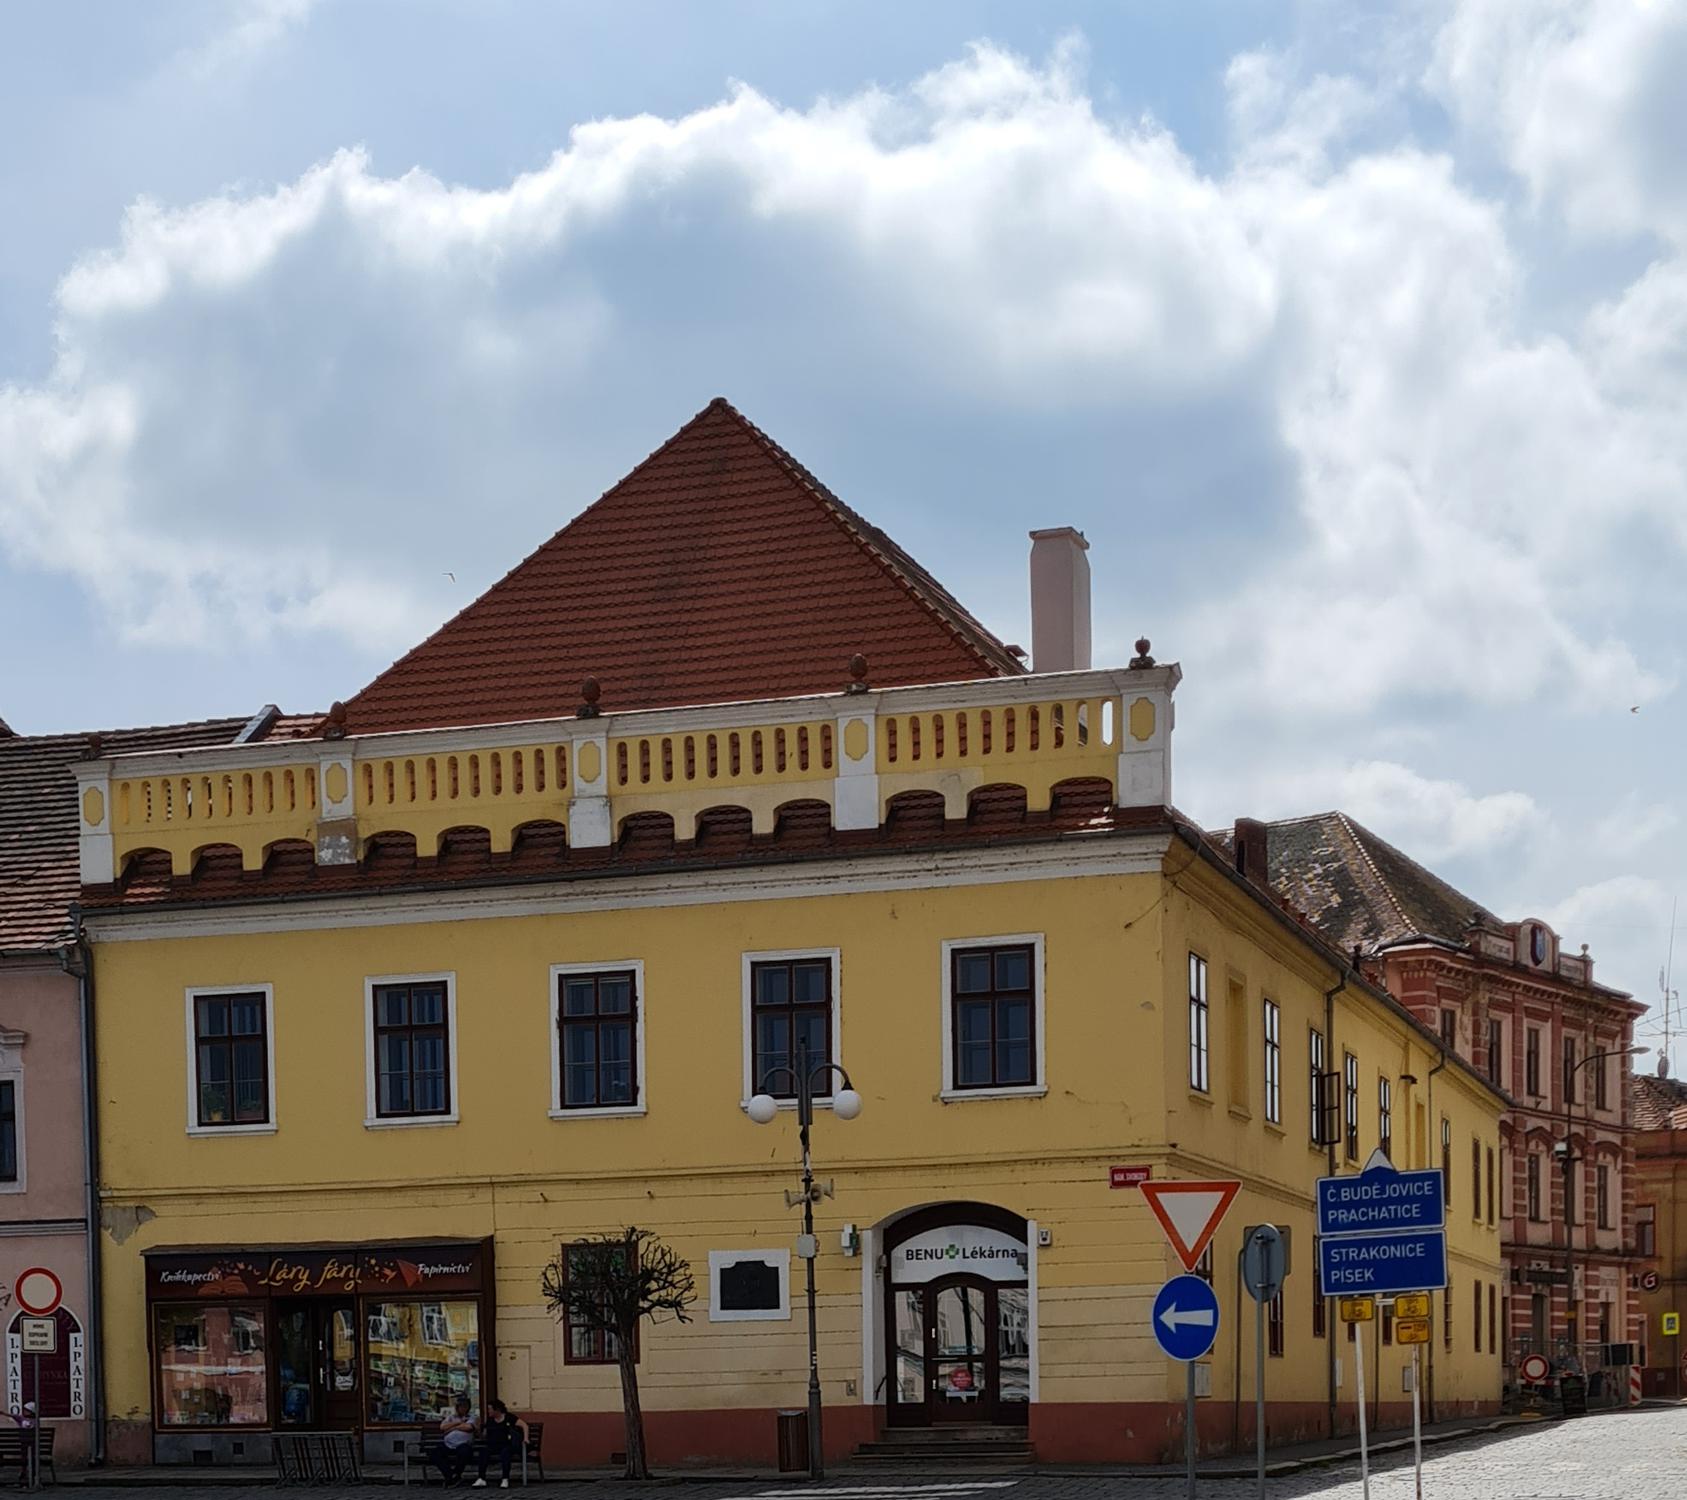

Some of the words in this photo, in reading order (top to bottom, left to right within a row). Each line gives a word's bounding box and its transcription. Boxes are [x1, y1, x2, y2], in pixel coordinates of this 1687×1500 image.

[1328, 1204, 1421, 1224] PRACHATICE
[906, 1249, 944, 1260] BENU
[963, 1246, 1018, 1259] Lékárna
[1331, 1243, 1425, 1262] STRAKONICE
[257, 1257, 311, 1292] Láry
[417, 1262, 473, 1279] Papírnictví
[1331, 1267, 1374, 1284] PÍSEK
[73, 1352, 83, 1415] PATRO
